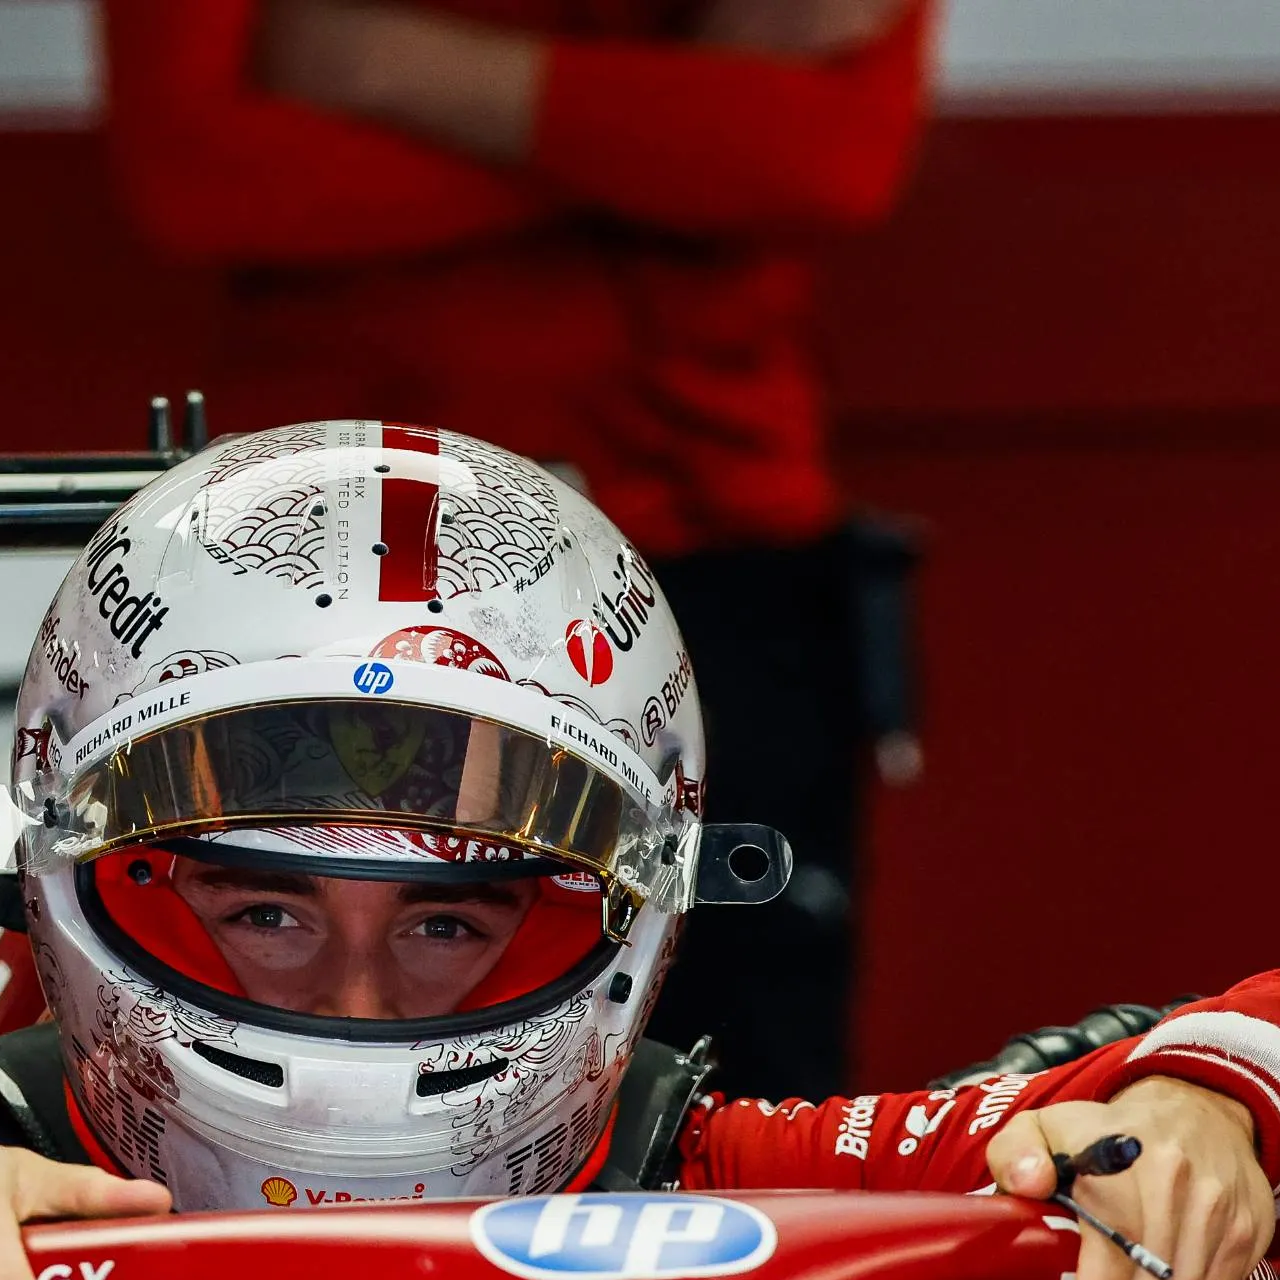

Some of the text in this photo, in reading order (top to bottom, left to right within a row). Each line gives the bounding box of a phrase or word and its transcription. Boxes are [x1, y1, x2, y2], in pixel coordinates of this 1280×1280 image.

[337, 520, 350, 600] EDITION
[356, 662, 392, 696] hp
[74, 691, 192, 765] RICHARD MILLE
[520, 1194, 730, 1276] hp
